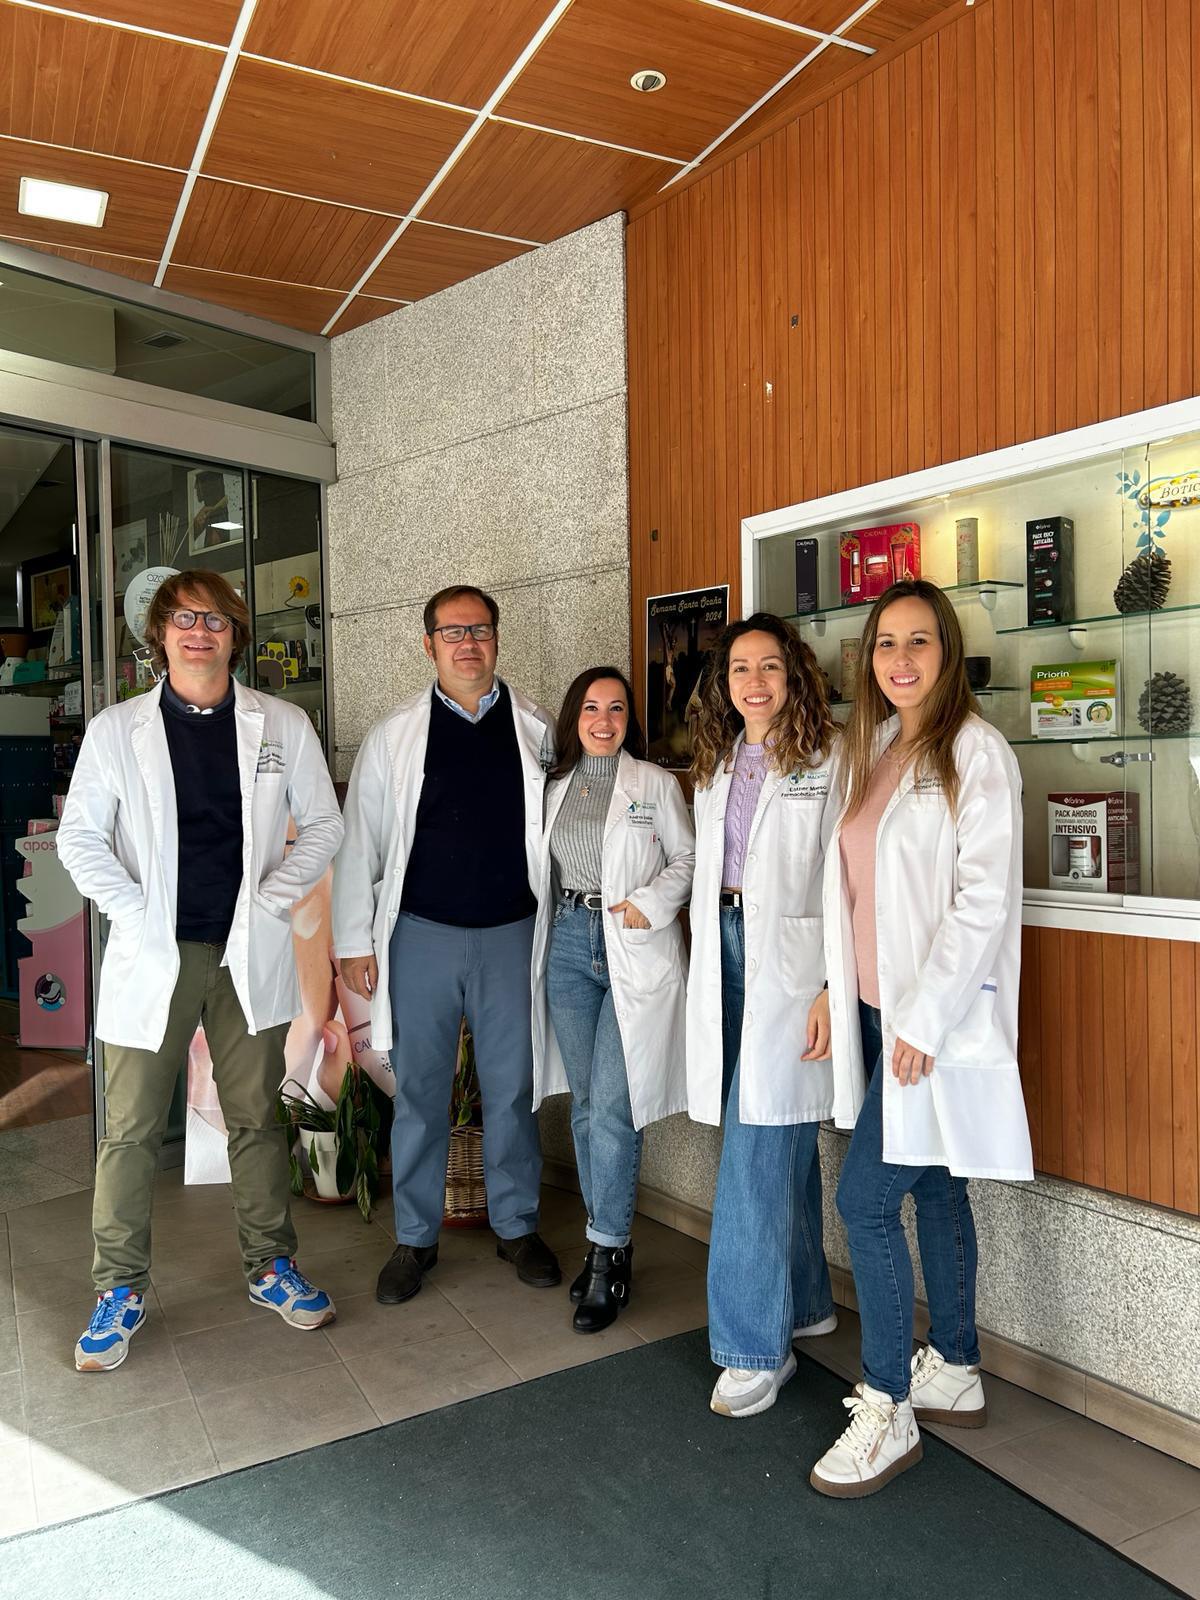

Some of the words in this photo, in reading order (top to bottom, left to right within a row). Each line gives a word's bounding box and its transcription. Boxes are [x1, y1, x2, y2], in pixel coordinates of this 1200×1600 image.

[650, 603, 677, 616] Semana
[678, 600, 699, 612] Santa
[700, 596, 722, 608] Ocaña
[705, 611, 723, 621] 2024
[1037, 671, 1070, 679] Priorin
[1055, 810, 1070, 818] PACK
[1072, 810, 1097, 818] AHORRO
[1056, 825, 1097, 834] INTENSIVO
